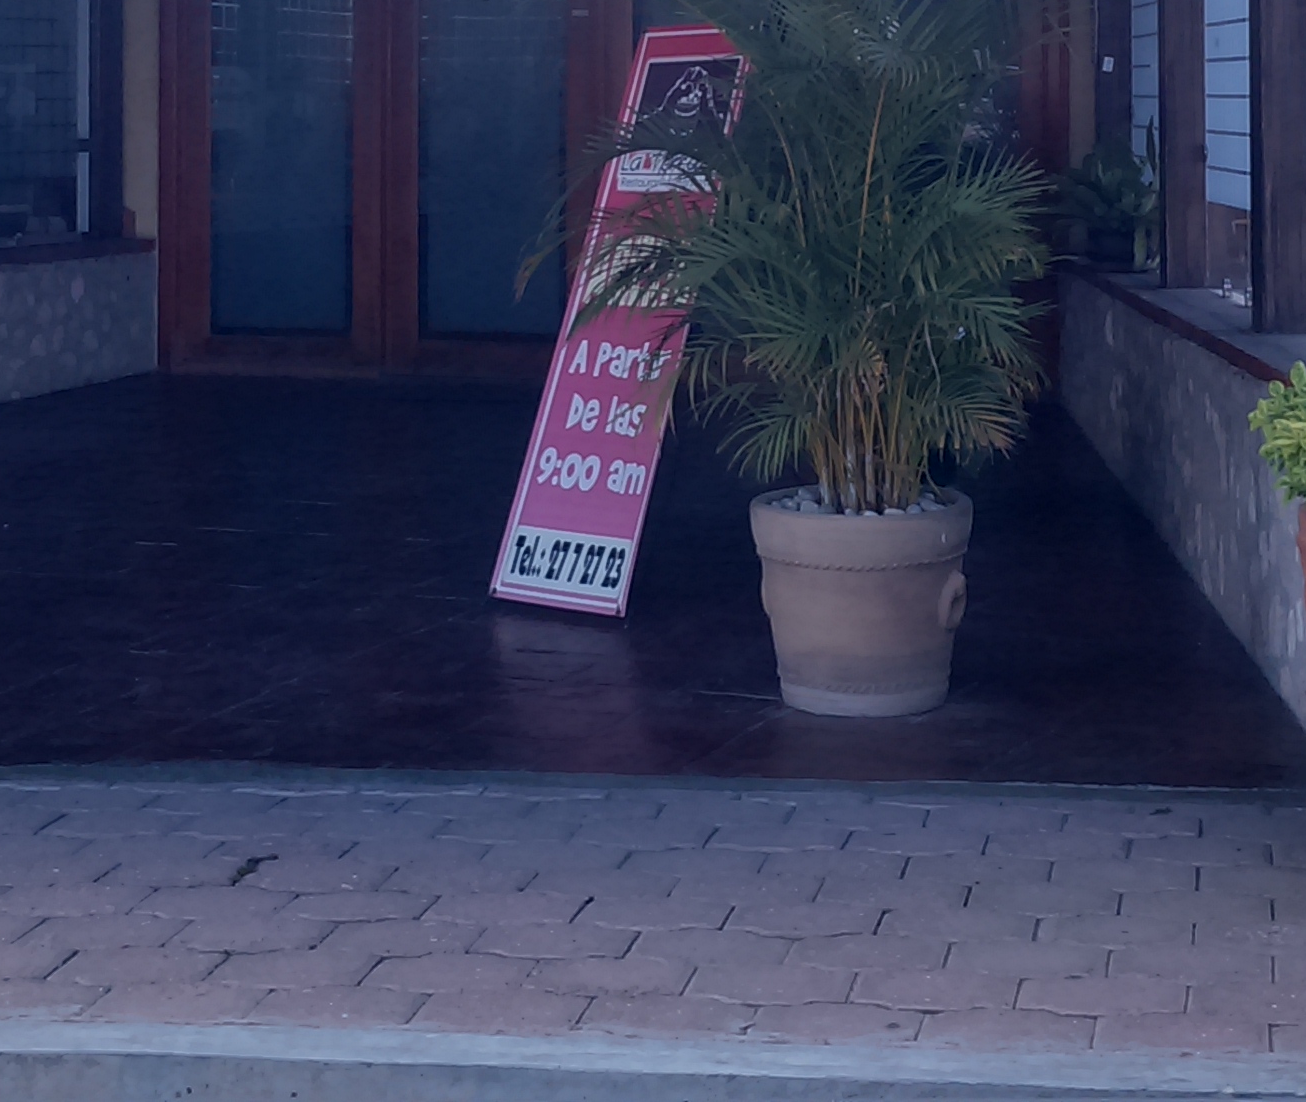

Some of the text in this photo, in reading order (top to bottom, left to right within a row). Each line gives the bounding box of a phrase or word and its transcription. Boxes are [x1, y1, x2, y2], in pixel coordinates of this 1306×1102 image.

[568, 339, 589, 375] A
[565, 392, 647, 438] De las
[536, 447, 647, 496] 9:00 am
